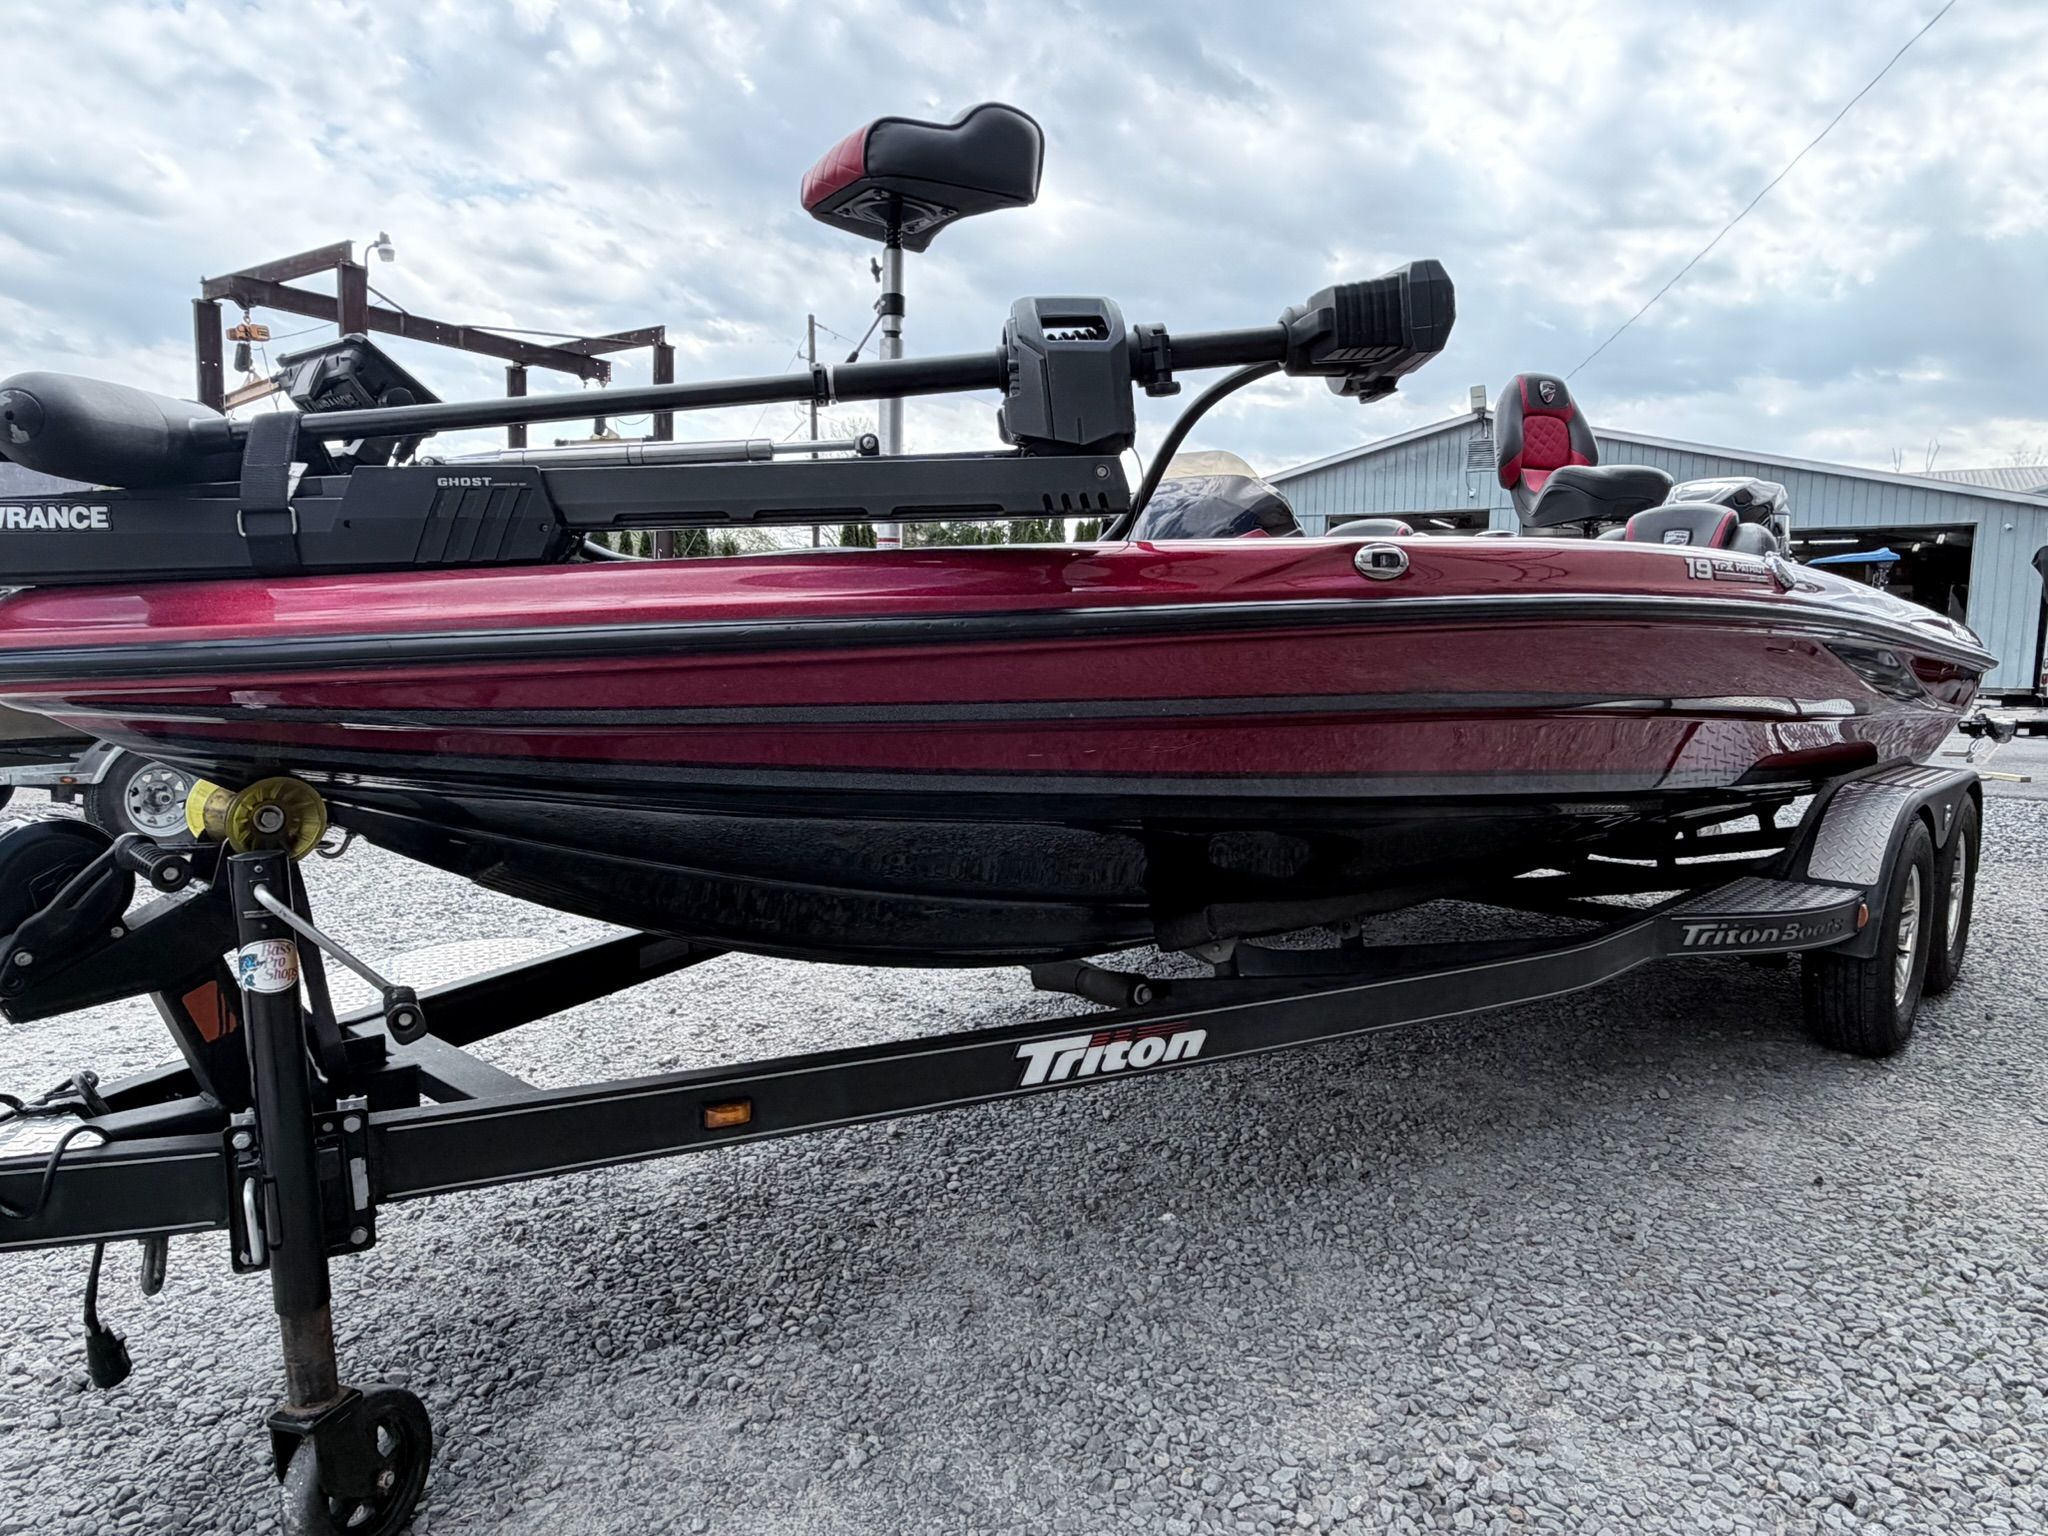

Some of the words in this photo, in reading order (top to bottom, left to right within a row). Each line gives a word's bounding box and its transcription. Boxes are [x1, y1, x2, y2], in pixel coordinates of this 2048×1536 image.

[437, 477, 492, 487] GHOST
[0, 505, 109, 530] RANCE
[1684, 557, 1713, 580] 19
[1682, 923, 1780, 946] Triton
[261, 943, 292, 957] Bass
[264, 956, 286, 969] Pro
[1016, 1028, 1207, 1087] Triton
